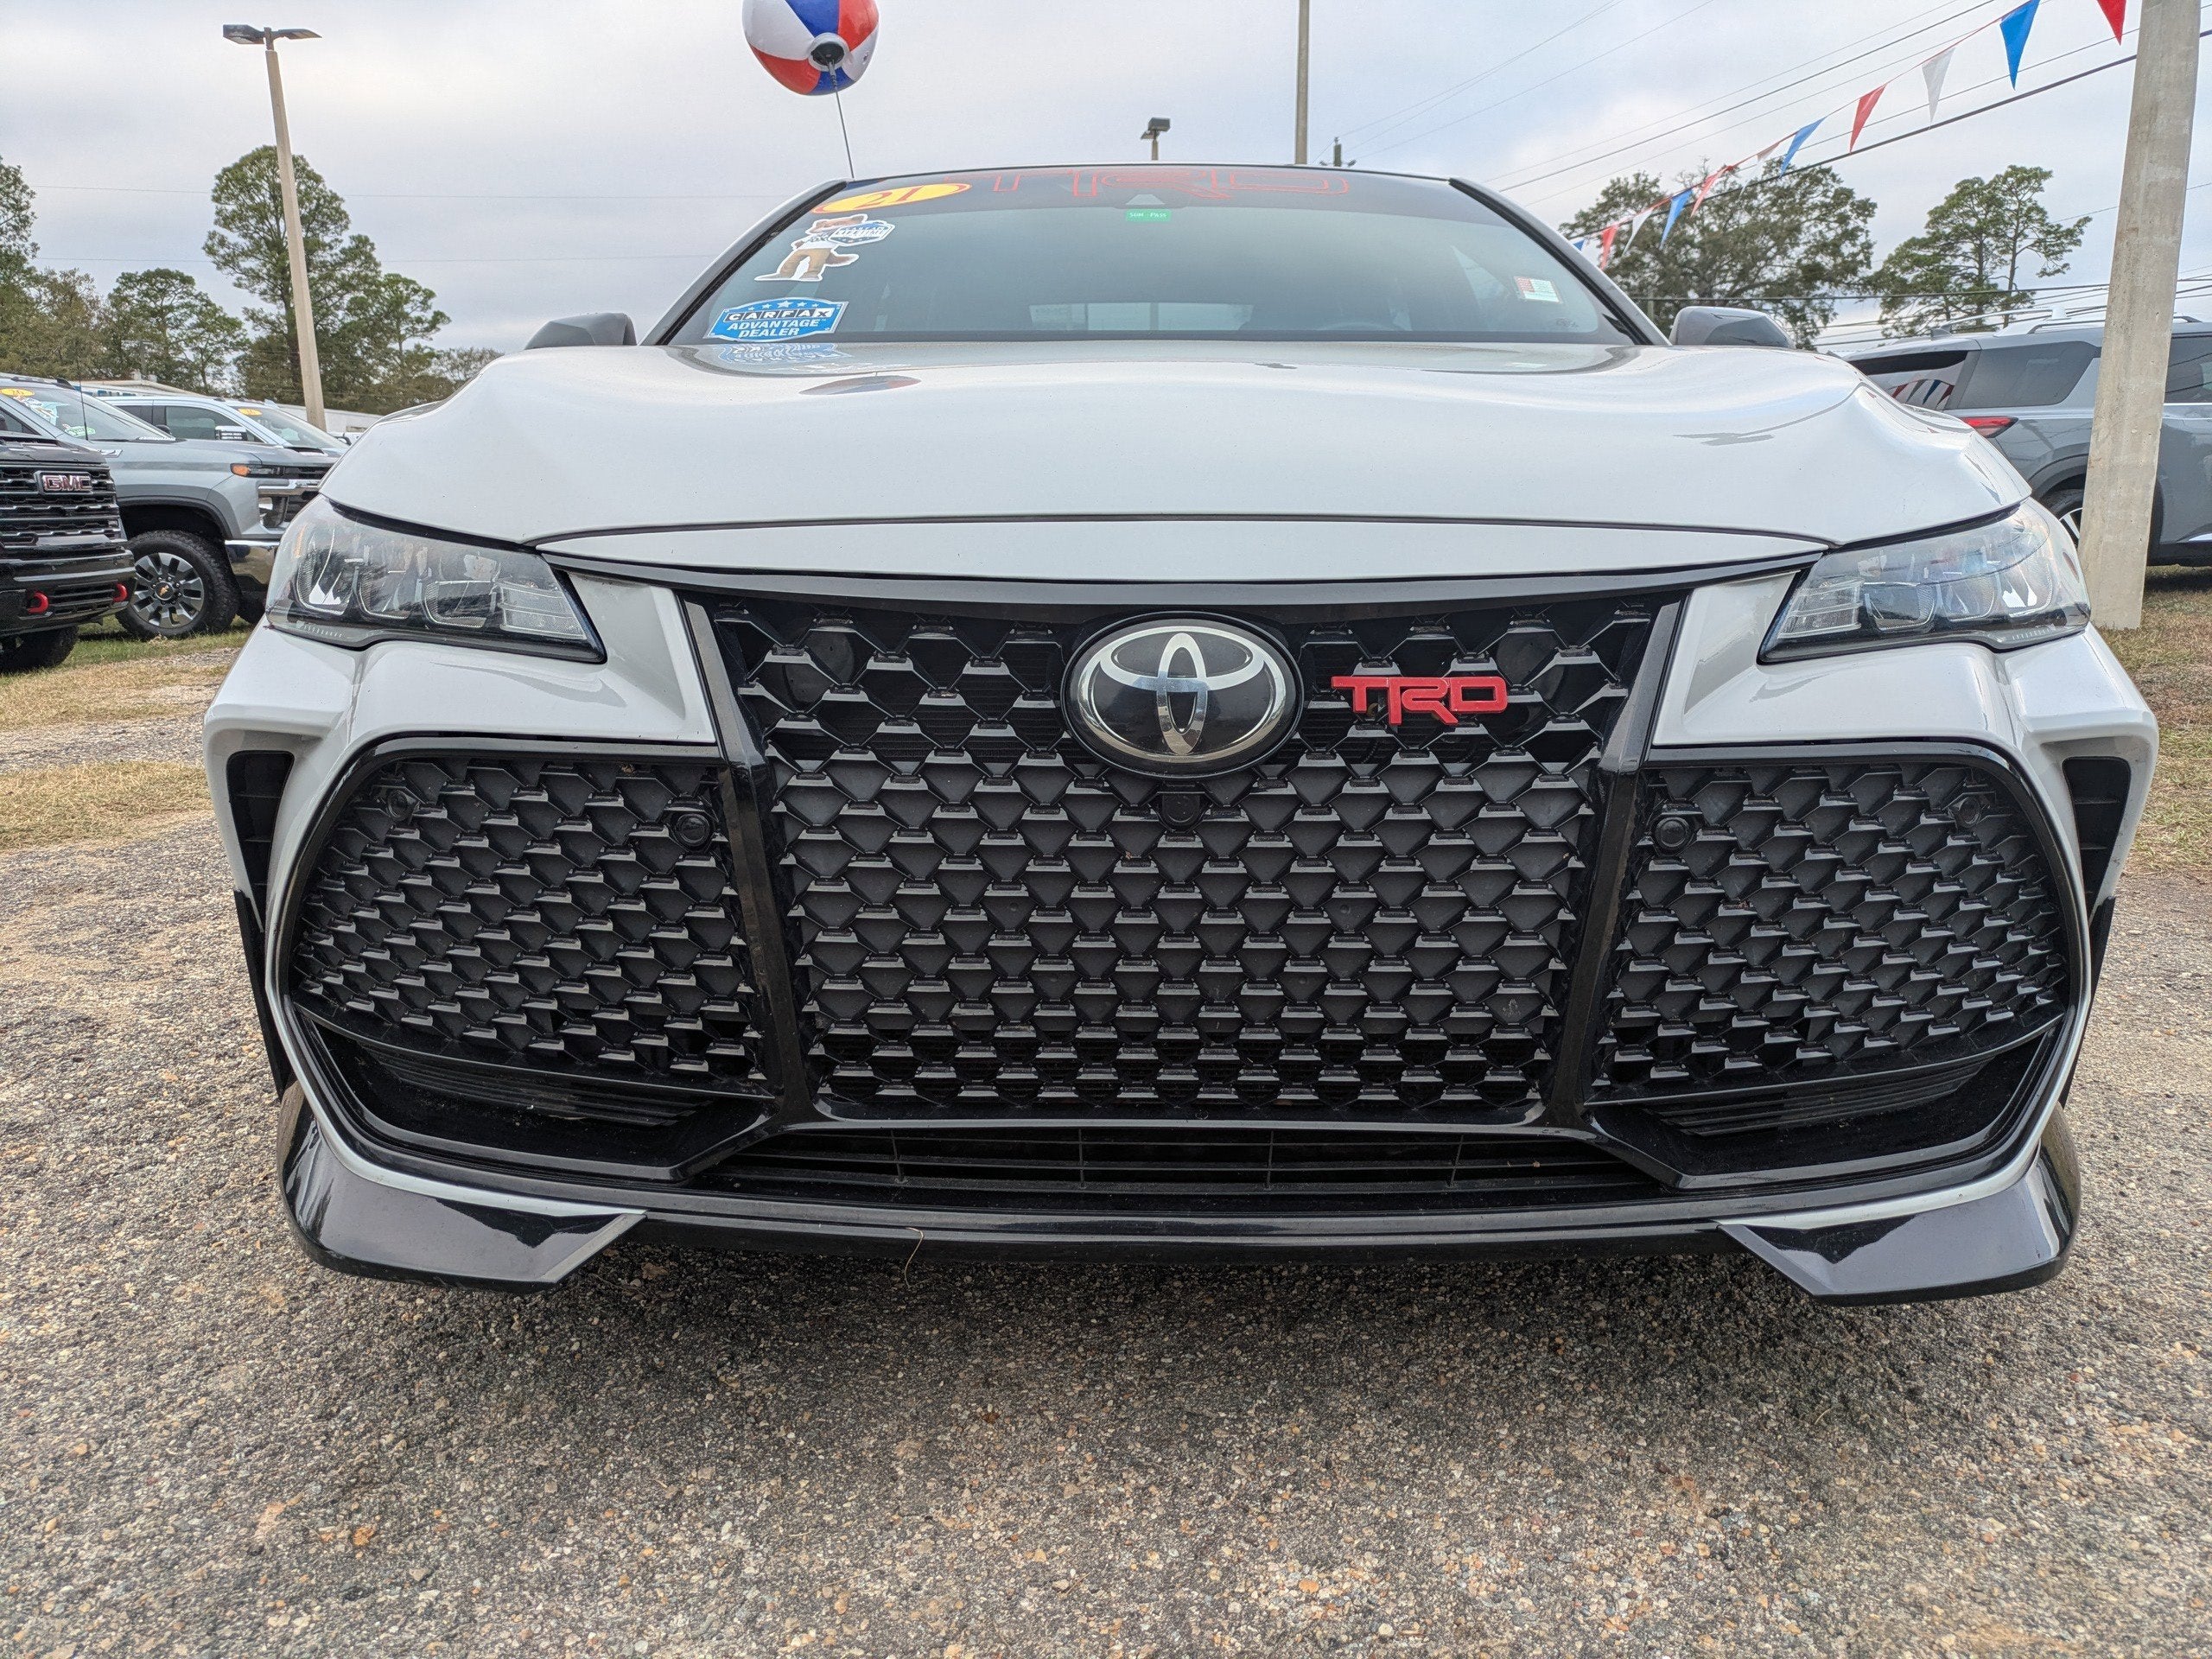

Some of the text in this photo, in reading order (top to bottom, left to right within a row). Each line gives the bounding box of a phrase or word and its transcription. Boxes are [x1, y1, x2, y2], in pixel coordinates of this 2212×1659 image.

[852, 185, 925, 209] 21
[726, 308, 834, 321] CARFAX
[727, 319, 820, 331] ADVANTAGE
[738, 327, 800, 338] DEALER
[42, 474, 92, 492] GMC
[1331, 676, 1509, 727] TRD
